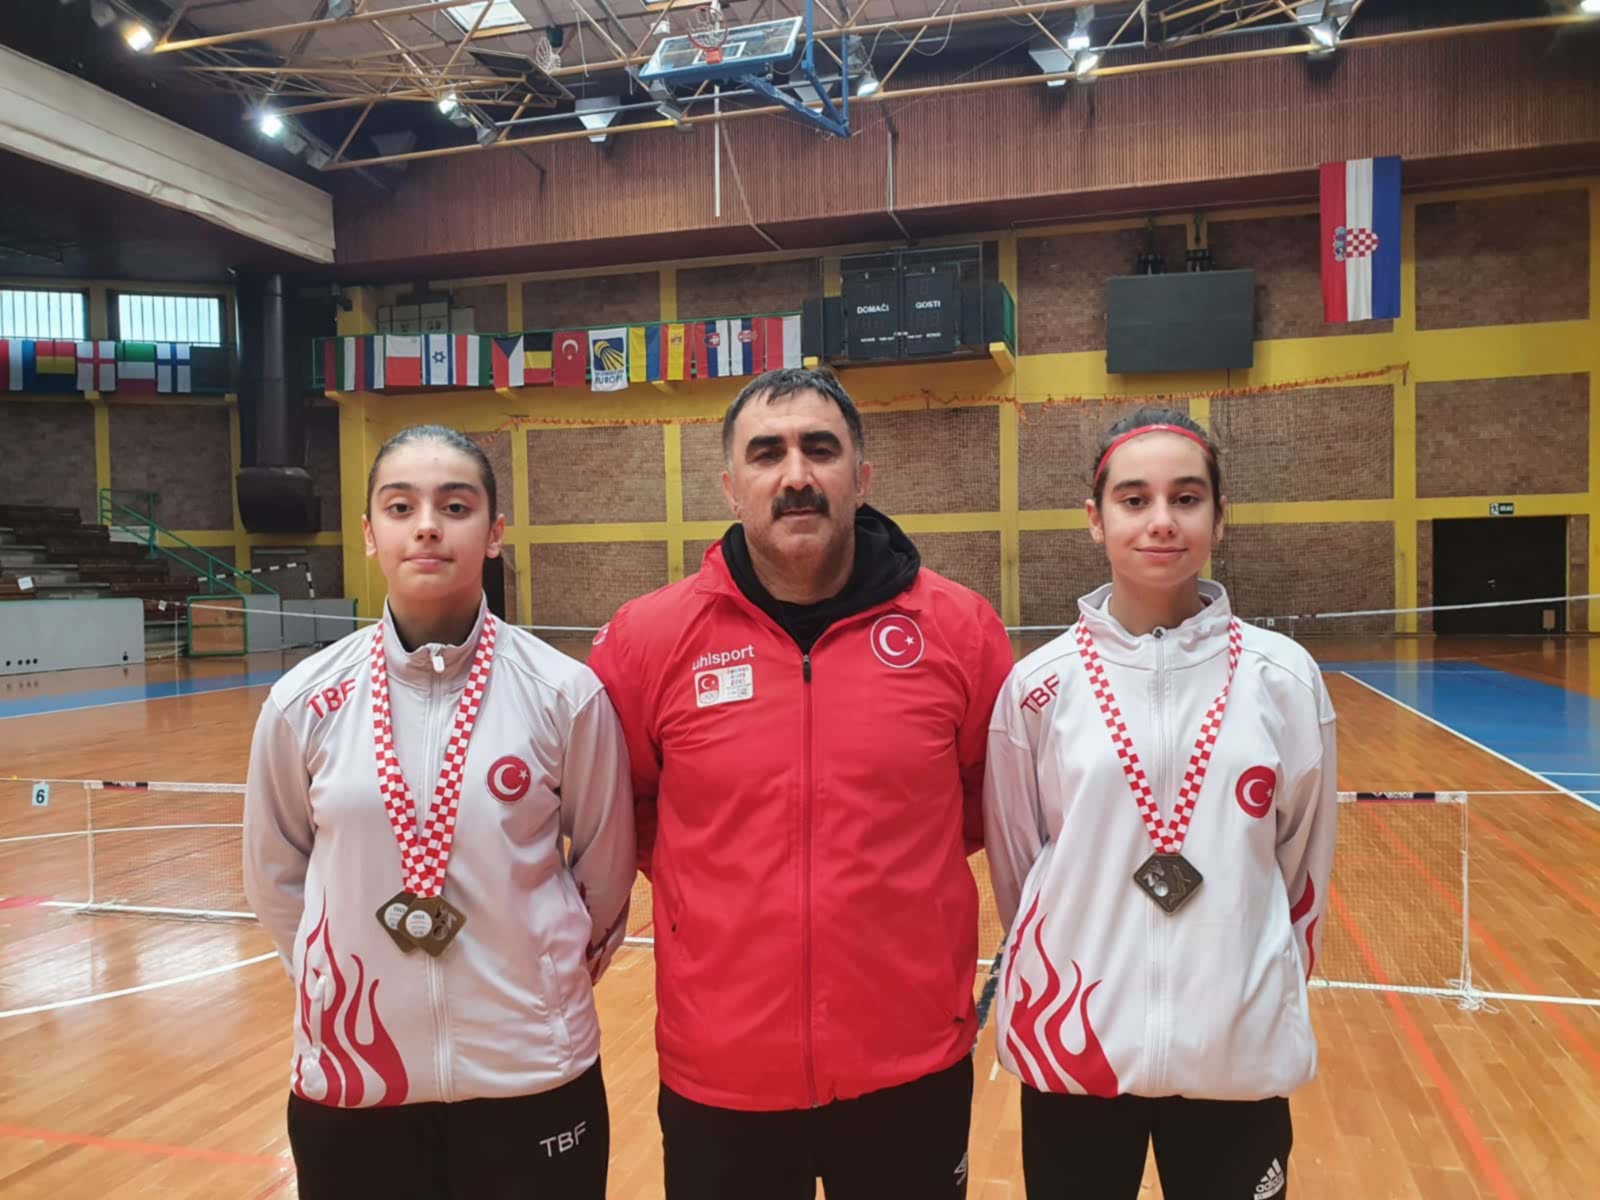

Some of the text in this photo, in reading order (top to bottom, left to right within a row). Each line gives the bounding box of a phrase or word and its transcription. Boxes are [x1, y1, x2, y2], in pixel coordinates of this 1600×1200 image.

[915, 300, 941, 309] GOSTI
[692, 644, 754, 671] uhlsport
[306, 678, 356, 719] TBF
[1020, 674, 1060, 714] TBF
[36, 789, 45, 804] 6
[539, 1120, 587, 1158] TBF
